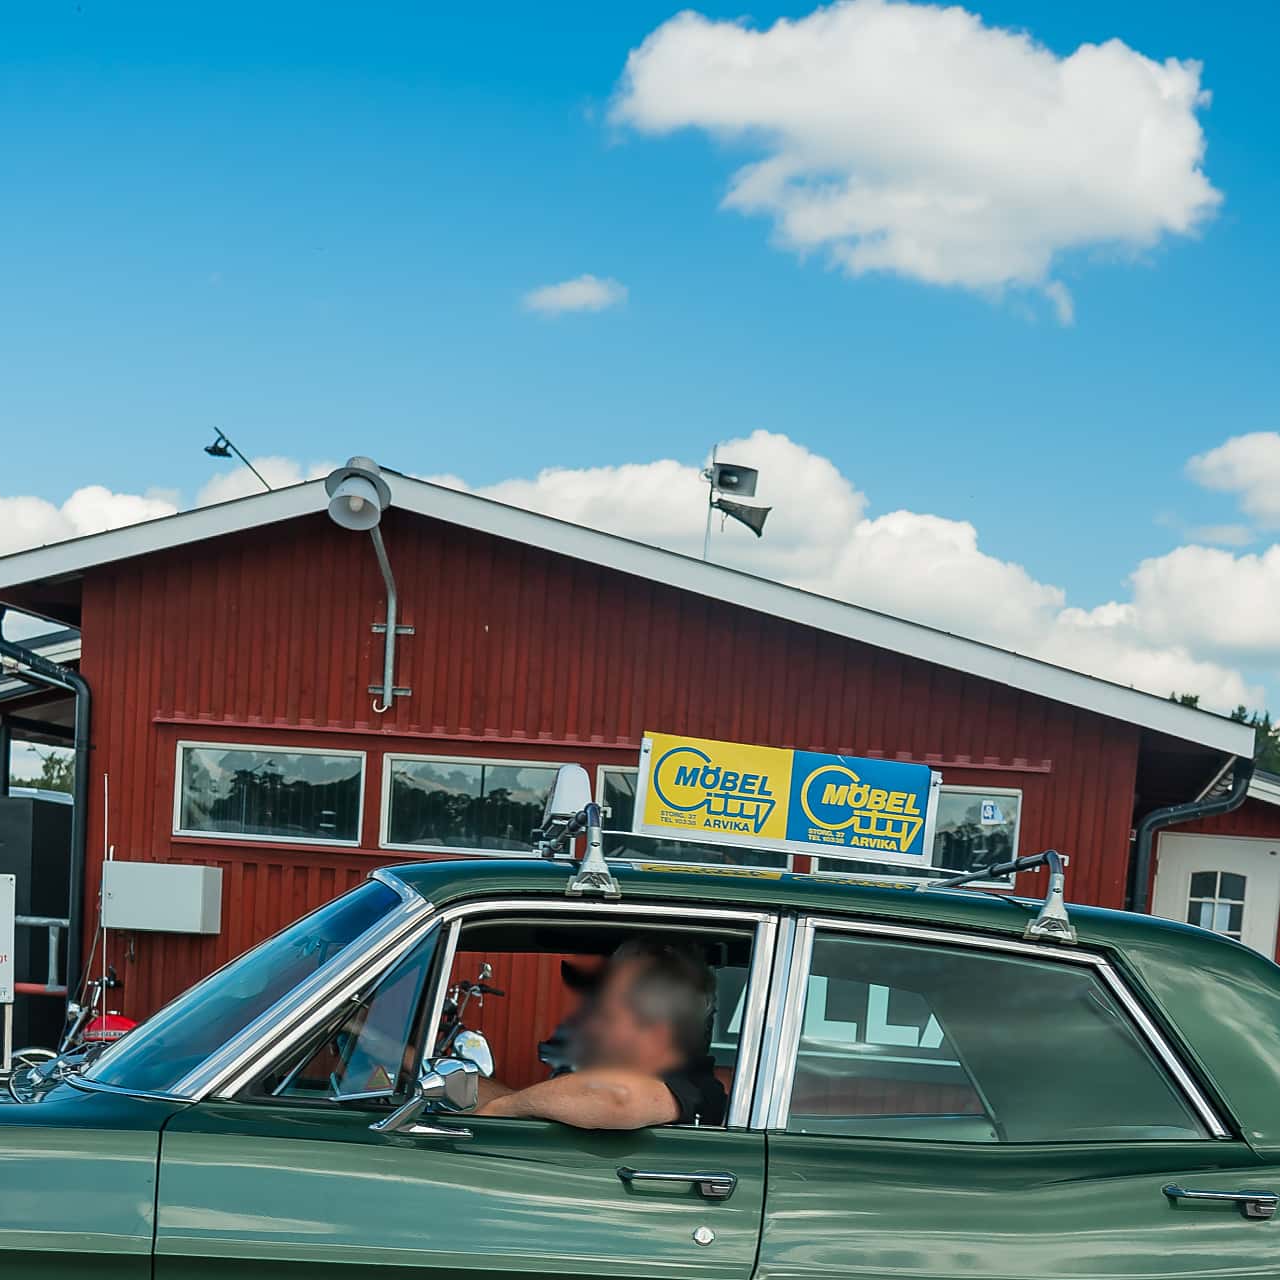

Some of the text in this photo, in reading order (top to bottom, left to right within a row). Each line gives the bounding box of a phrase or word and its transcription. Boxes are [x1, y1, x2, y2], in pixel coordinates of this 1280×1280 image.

[674, 765, 774, 796] MÖBEL
[822, 783, 921, 815] MÖBEL
[704, 818, 750, 832] ARVIKA
[850, 836, 898, 851] ARVIKA
